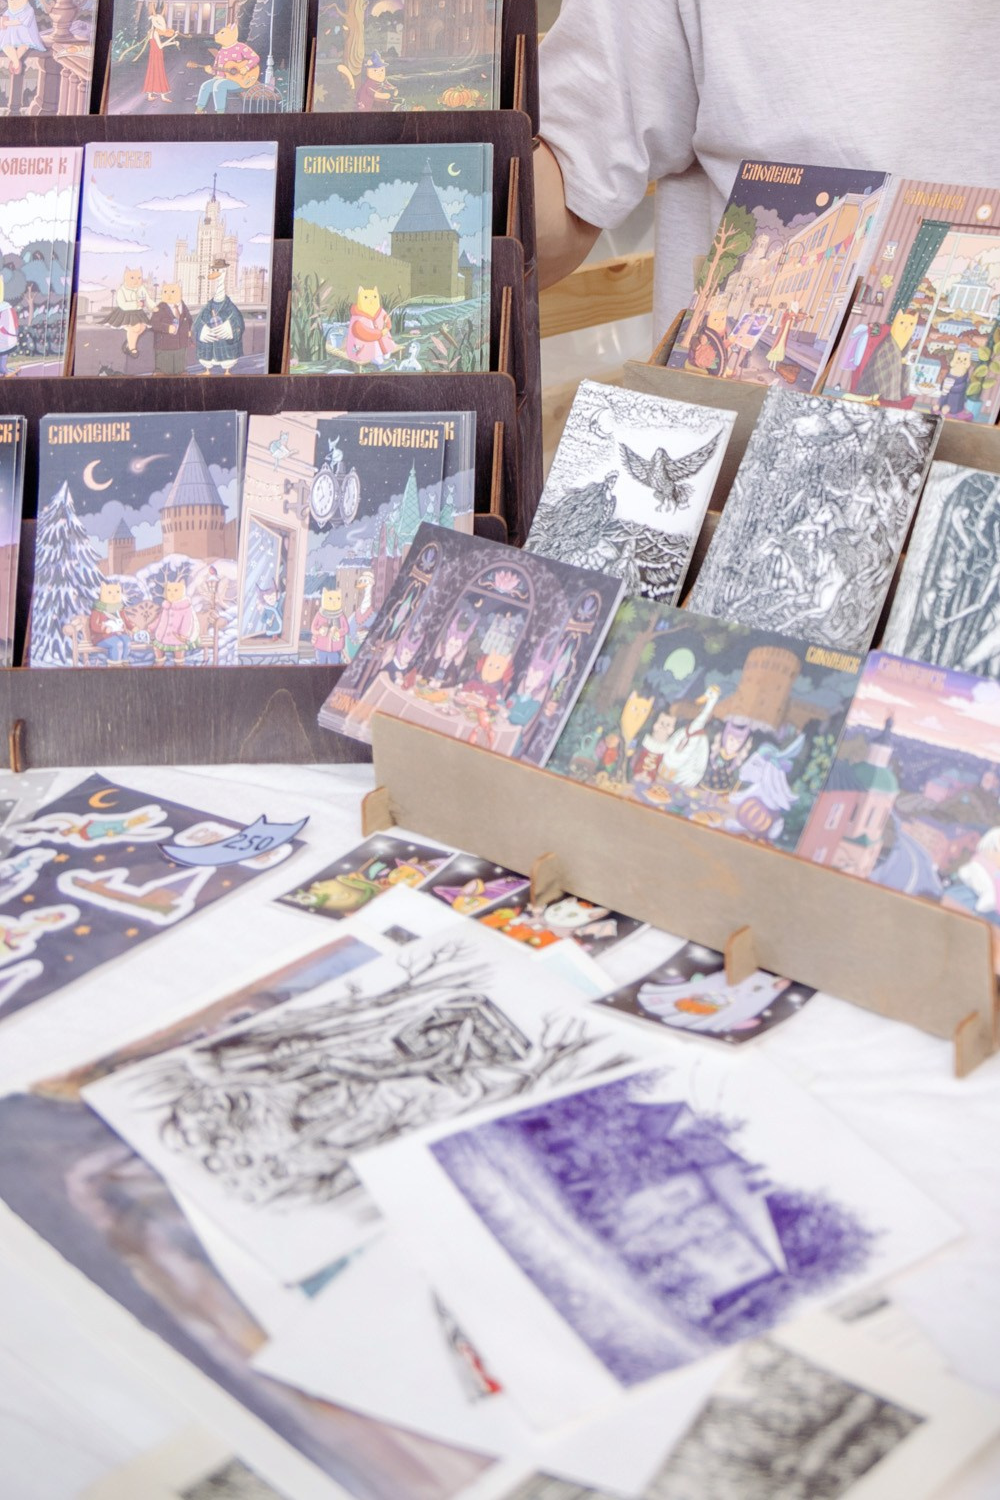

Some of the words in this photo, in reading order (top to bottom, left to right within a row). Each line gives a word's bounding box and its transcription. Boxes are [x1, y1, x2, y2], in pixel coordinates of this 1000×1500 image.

[0, 156, 54, 175] ОЛЕНСК
[303, 155, 380, 174] СМОЛЕНСК
[741, 162, 805, 186] СМОЛЕНСК
[48, 421, 131, 445] СМОЛЕНСК
[359, 426, 439, 449] СМОЛЕНСК
[221, 833, 275, 851] 250
